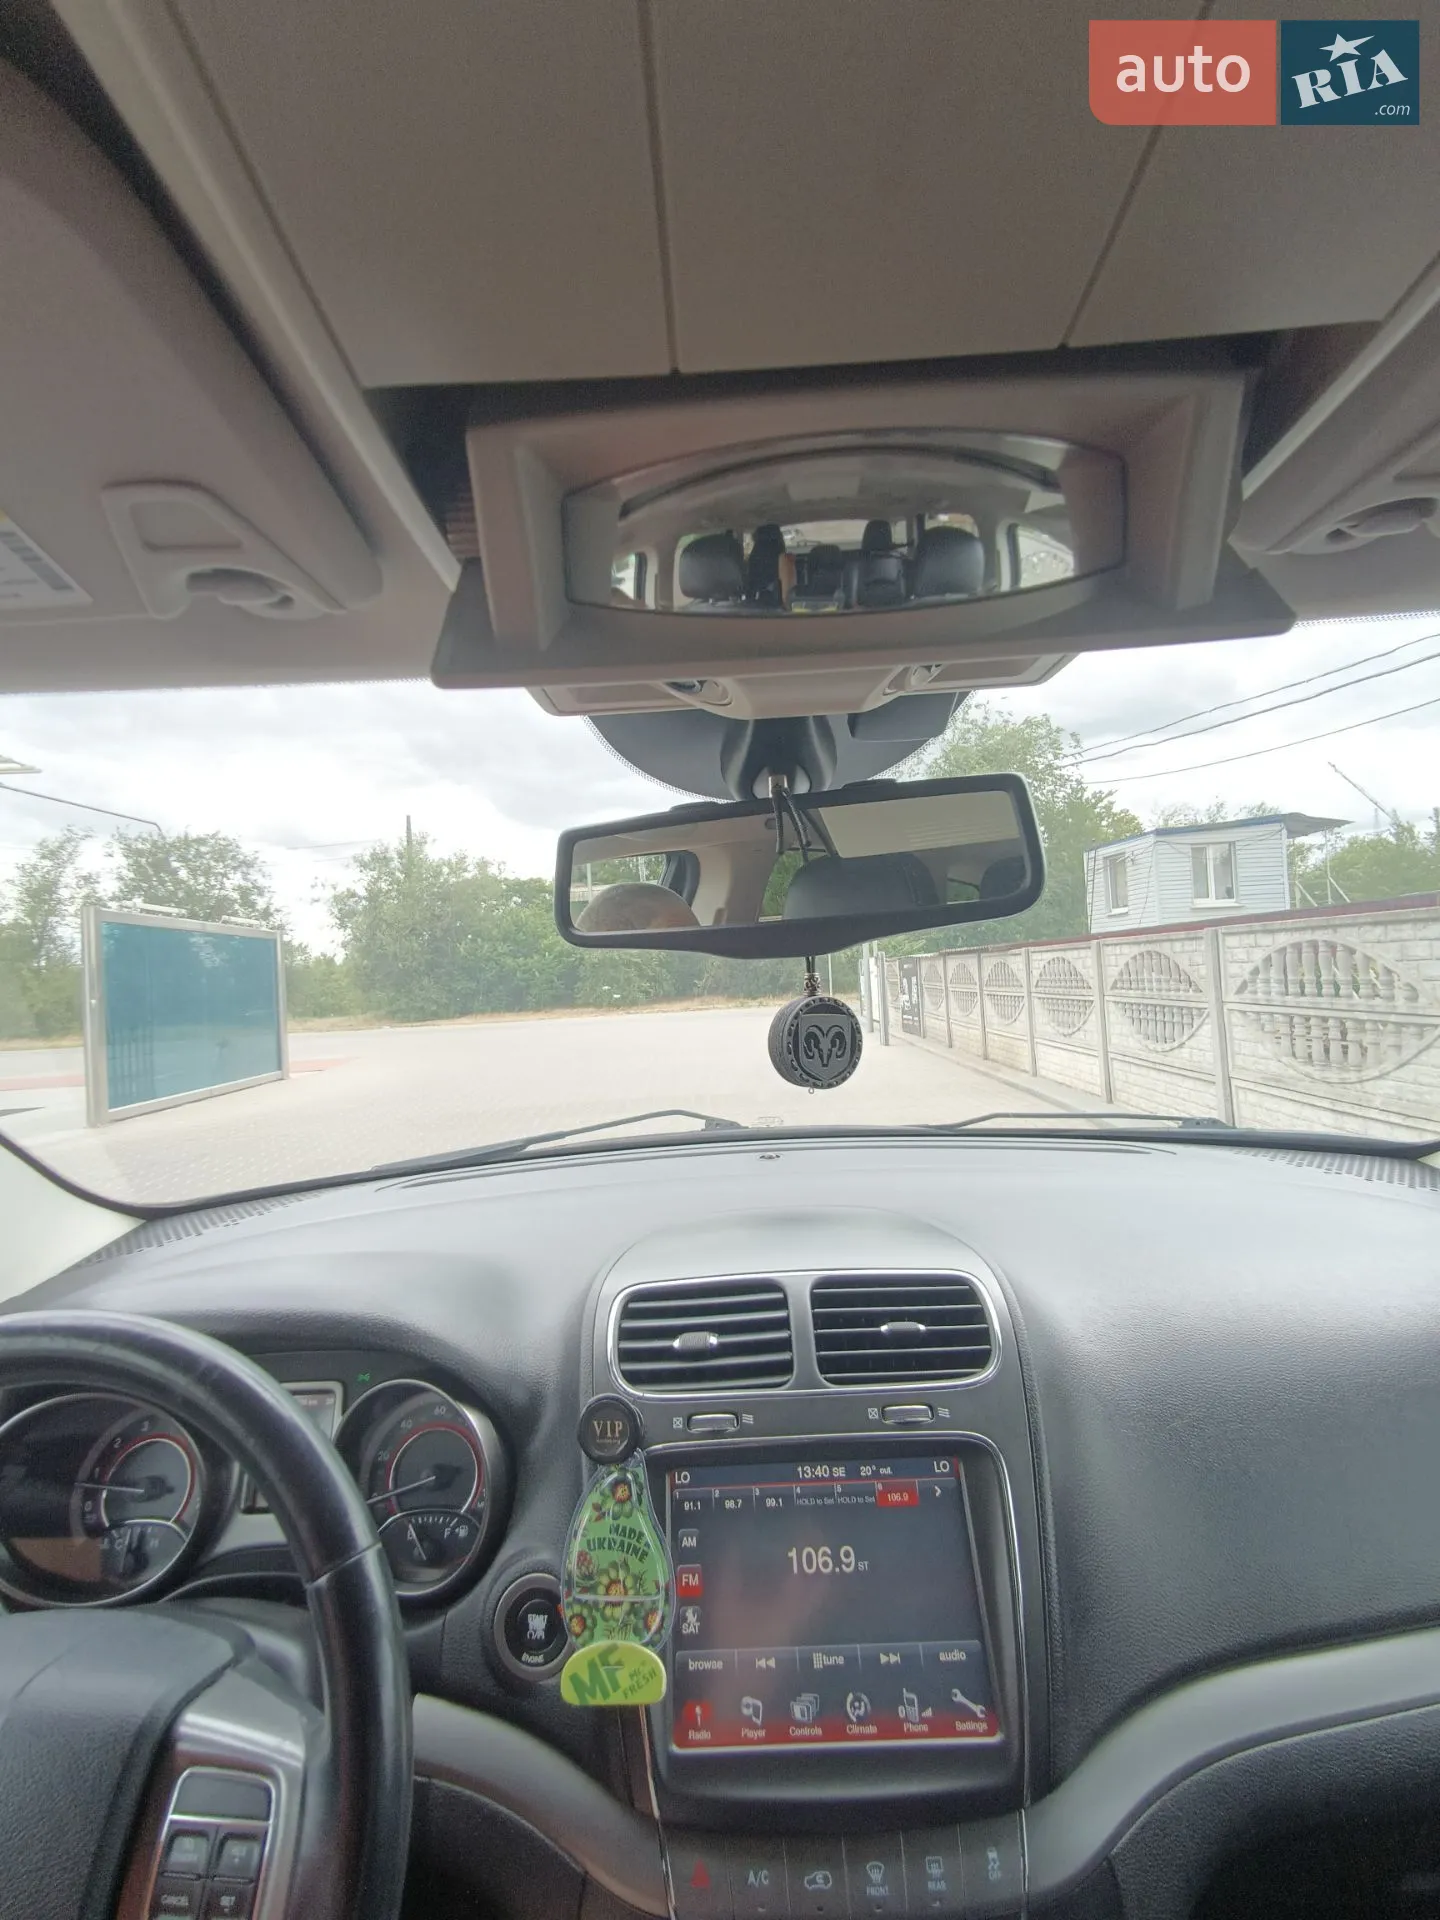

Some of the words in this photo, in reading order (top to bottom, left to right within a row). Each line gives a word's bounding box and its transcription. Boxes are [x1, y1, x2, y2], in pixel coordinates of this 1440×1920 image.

[592, 1419, 623, 1438] VIP
[797, 1465, 830, 1479] 13:40
[832, 1466, 847, 1477] SE
[934, 1460, 950, 1473] LO
[675, 1471, 691, 1484] LO
[684, 1501, 701, 1511] 91.1
[765, 1497, 783, 1507] 99.1
[609, 1523, 646, 1544] MADE
[681, 1536, 697, 1548] AM
[587, 1536, 649, 1564] UKRAINE
[787, 1545, 856, 1575] 106.9
[857, 1560, 869, 1572] ST
[681, 1573, 699, 1587] FM
[681, 1622, 701, 1635] SAT
[823, 1653, 844, 1666] tune
[939, 1648, 967, 1661] audio
[688, 1658, 723, 1671] browse
[789, 1725, 823, 1737] Controls
[846, 1723, 878, 1735] Climate
[903, 1722, 929, 1733] Phone
[955, 1720, 989, 1732] Settings
[688, 1729, 711, 1740] Radio
[741, 1727, 766, 1740] Player
[747, 1870, 770, 1888] A/C
